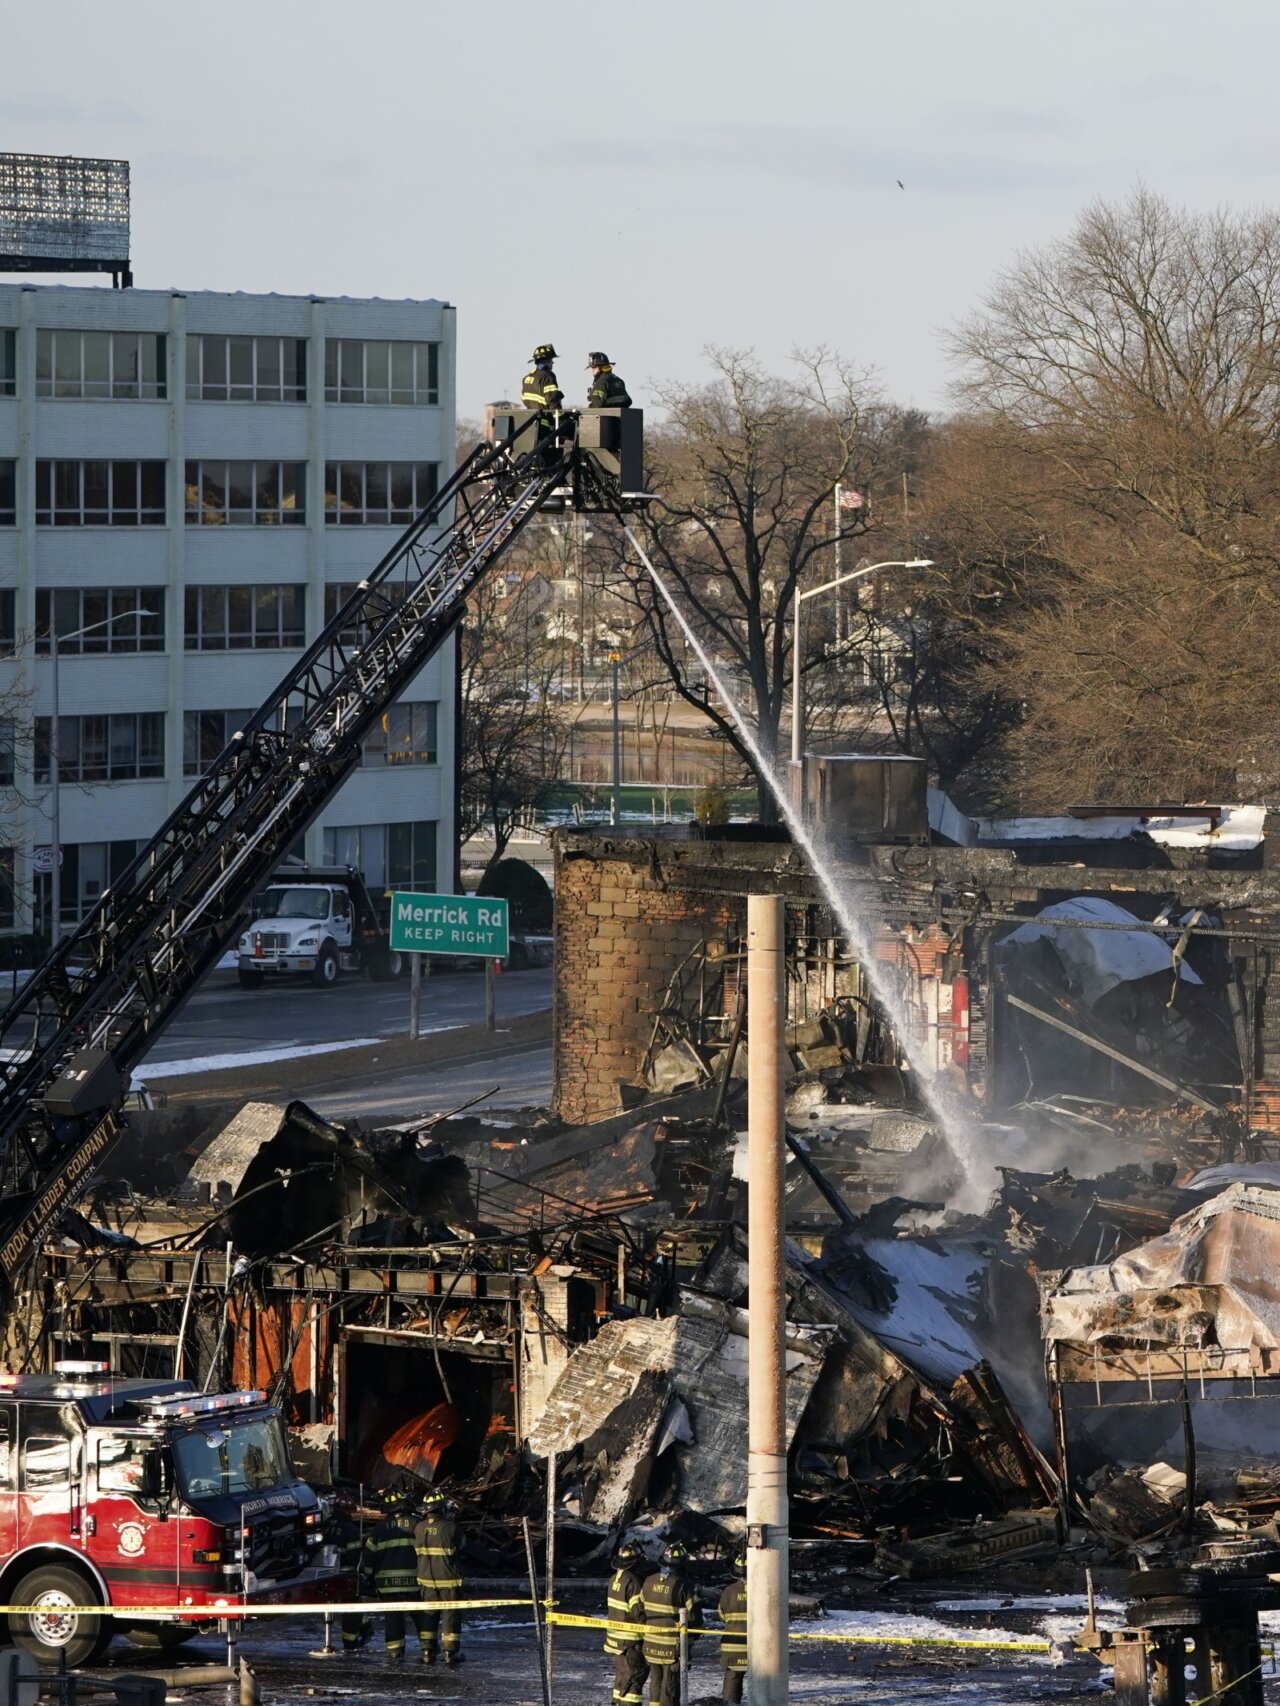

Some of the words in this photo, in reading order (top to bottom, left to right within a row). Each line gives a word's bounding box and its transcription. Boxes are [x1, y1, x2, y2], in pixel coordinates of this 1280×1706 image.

[397, 903, 468, 926] Merrick
[477, 907, 502, 928] Rd
[405, 927, 443, 940] KEEP
[451, 930, 494, 944] RIGHT
[0, 1226, 30, 1270] HOOK
[33, 1177, 68, 1226] LADDER
[66, 1123, 109, 1181] COMPANY
[106, 1112, 119, 1134] 1
[32, 1208, 60, 1247] NORTH
[60, 1162, 97, 1210] MERRICK
[244, 1498, 267, 1513] NORTH
